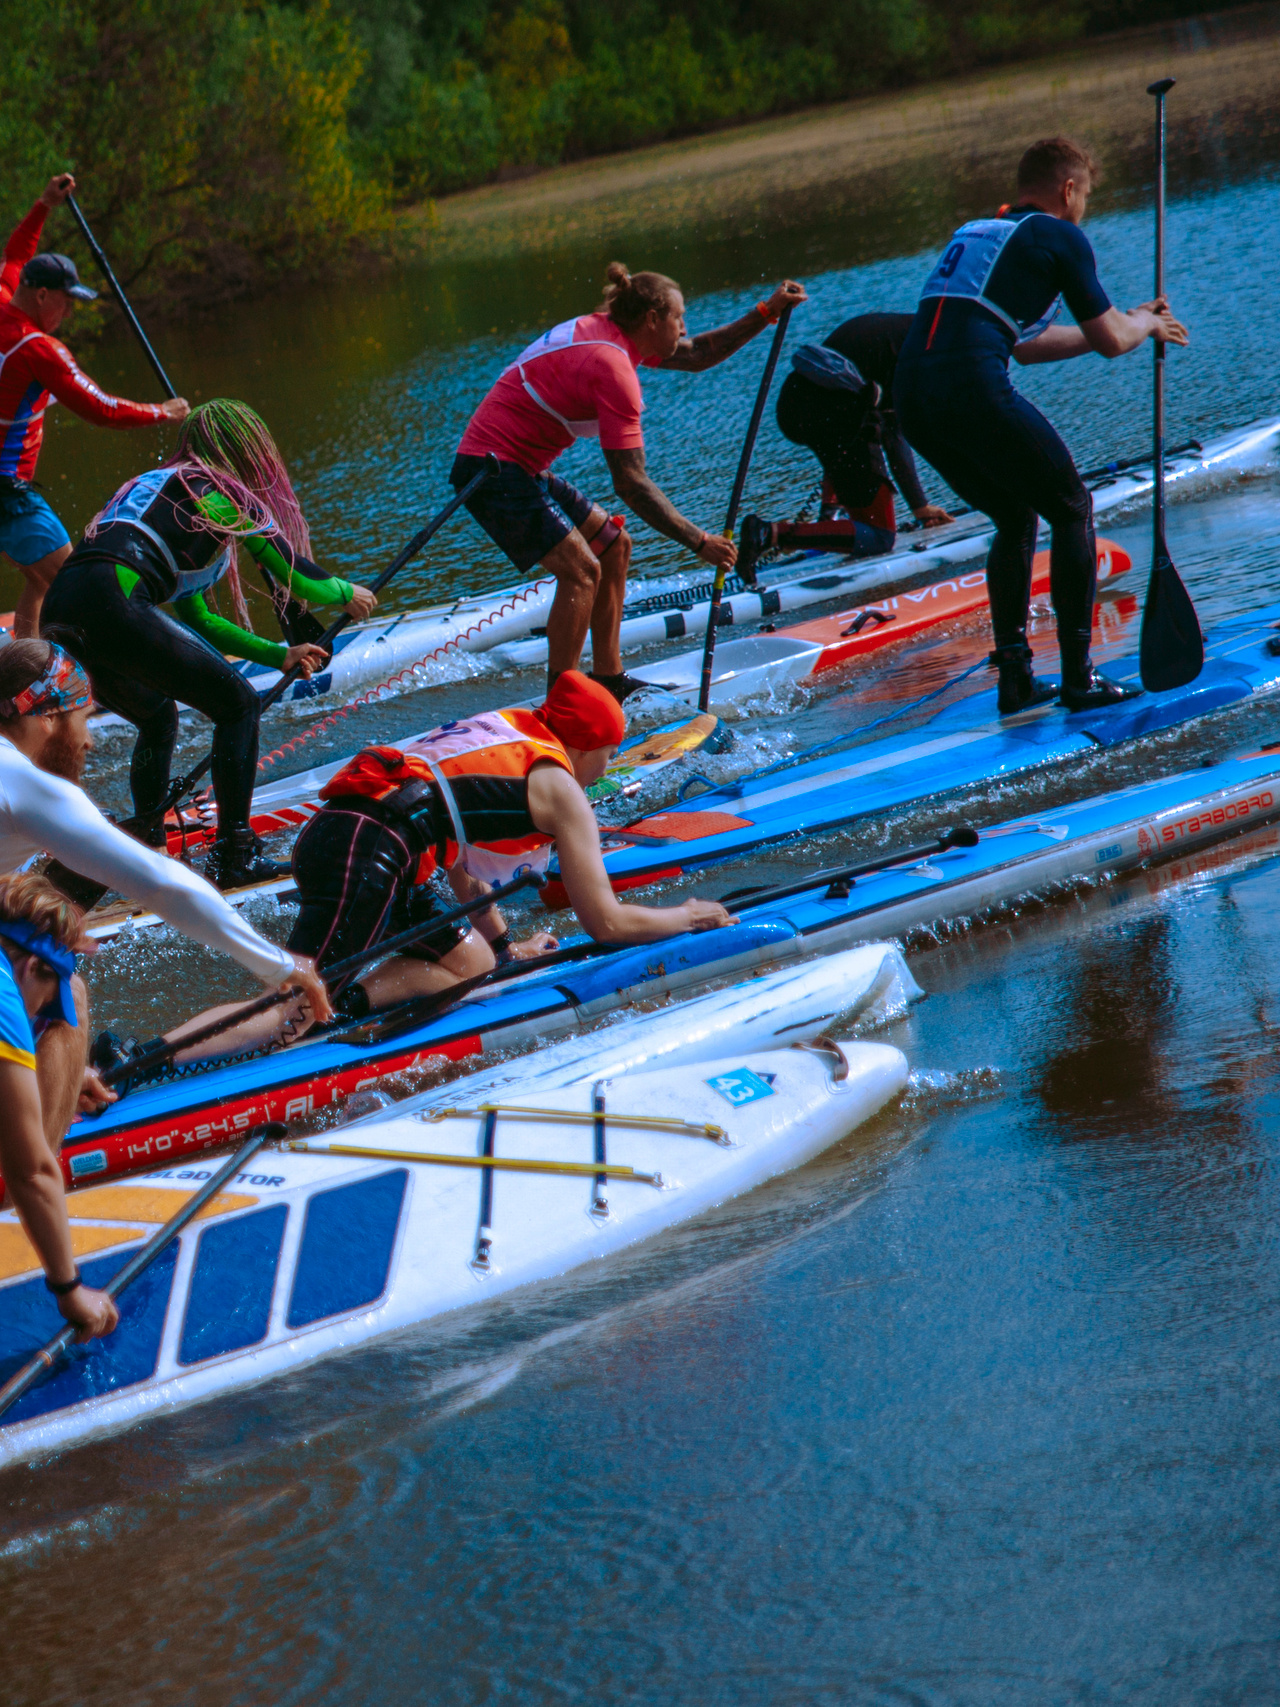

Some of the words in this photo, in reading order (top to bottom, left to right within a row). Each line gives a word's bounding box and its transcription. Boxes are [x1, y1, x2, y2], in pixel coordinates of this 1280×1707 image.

[938, 242, 965, 278] 9
[716, 1077, 755, 1102] 43
[142, 1170, 287, 1188] GLADTOR
